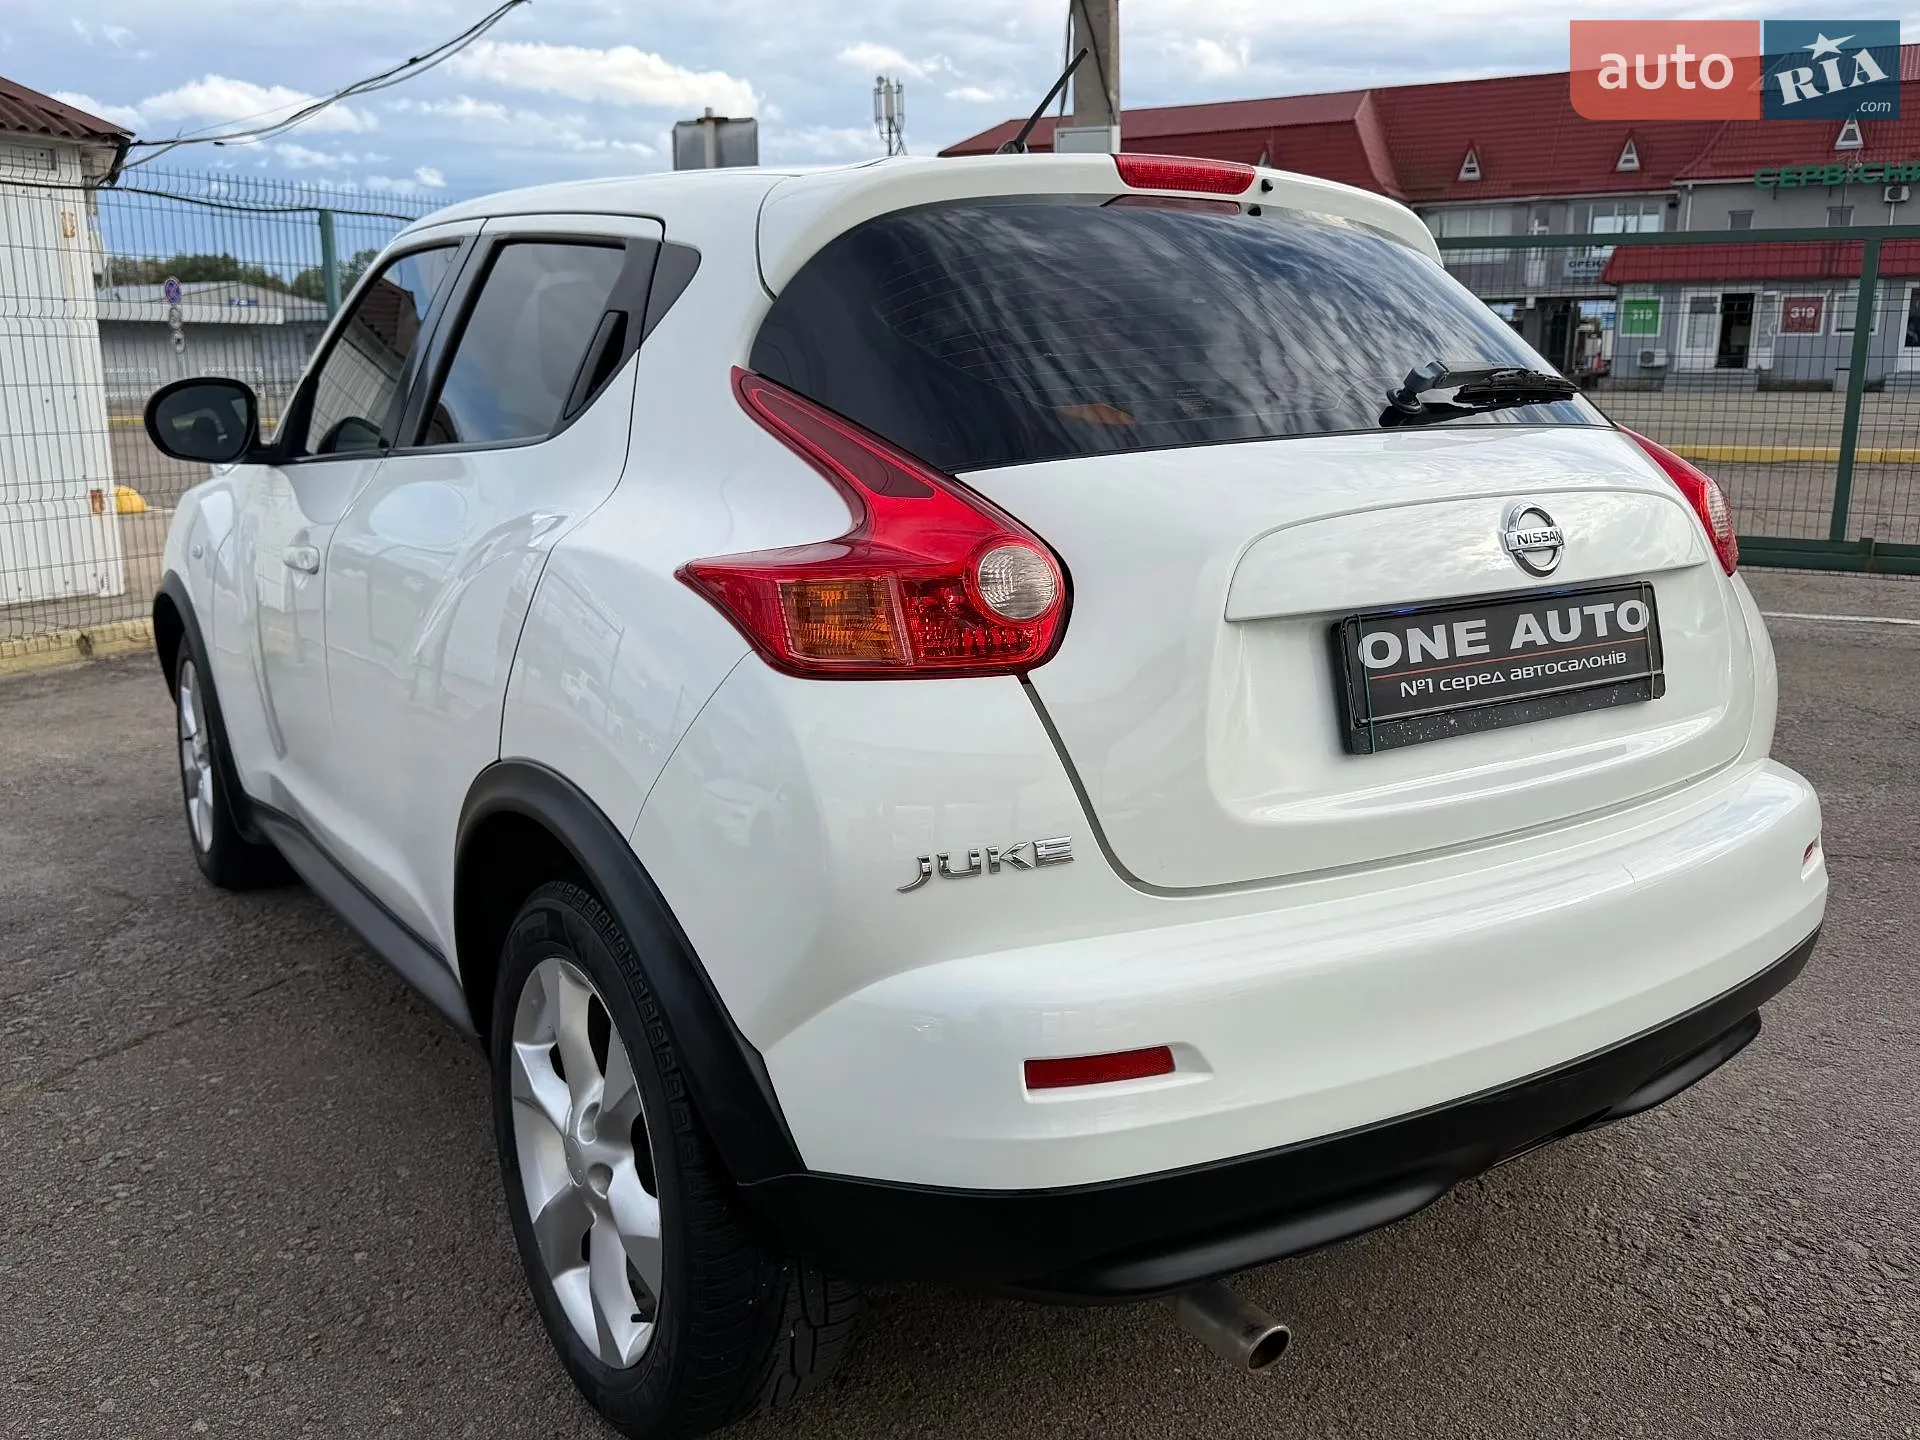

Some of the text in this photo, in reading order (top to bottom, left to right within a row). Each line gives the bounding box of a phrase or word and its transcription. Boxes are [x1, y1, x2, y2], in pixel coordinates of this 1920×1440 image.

[1516, 530, 1563, 546] NISSAN
[1357, 600, 1650, 670] ONE AUTO
[1439, 671, 1506, 694] серед
[1510, 650, 1627, 682] автосалонів
[896, 836, 1075, 894] JUKE
